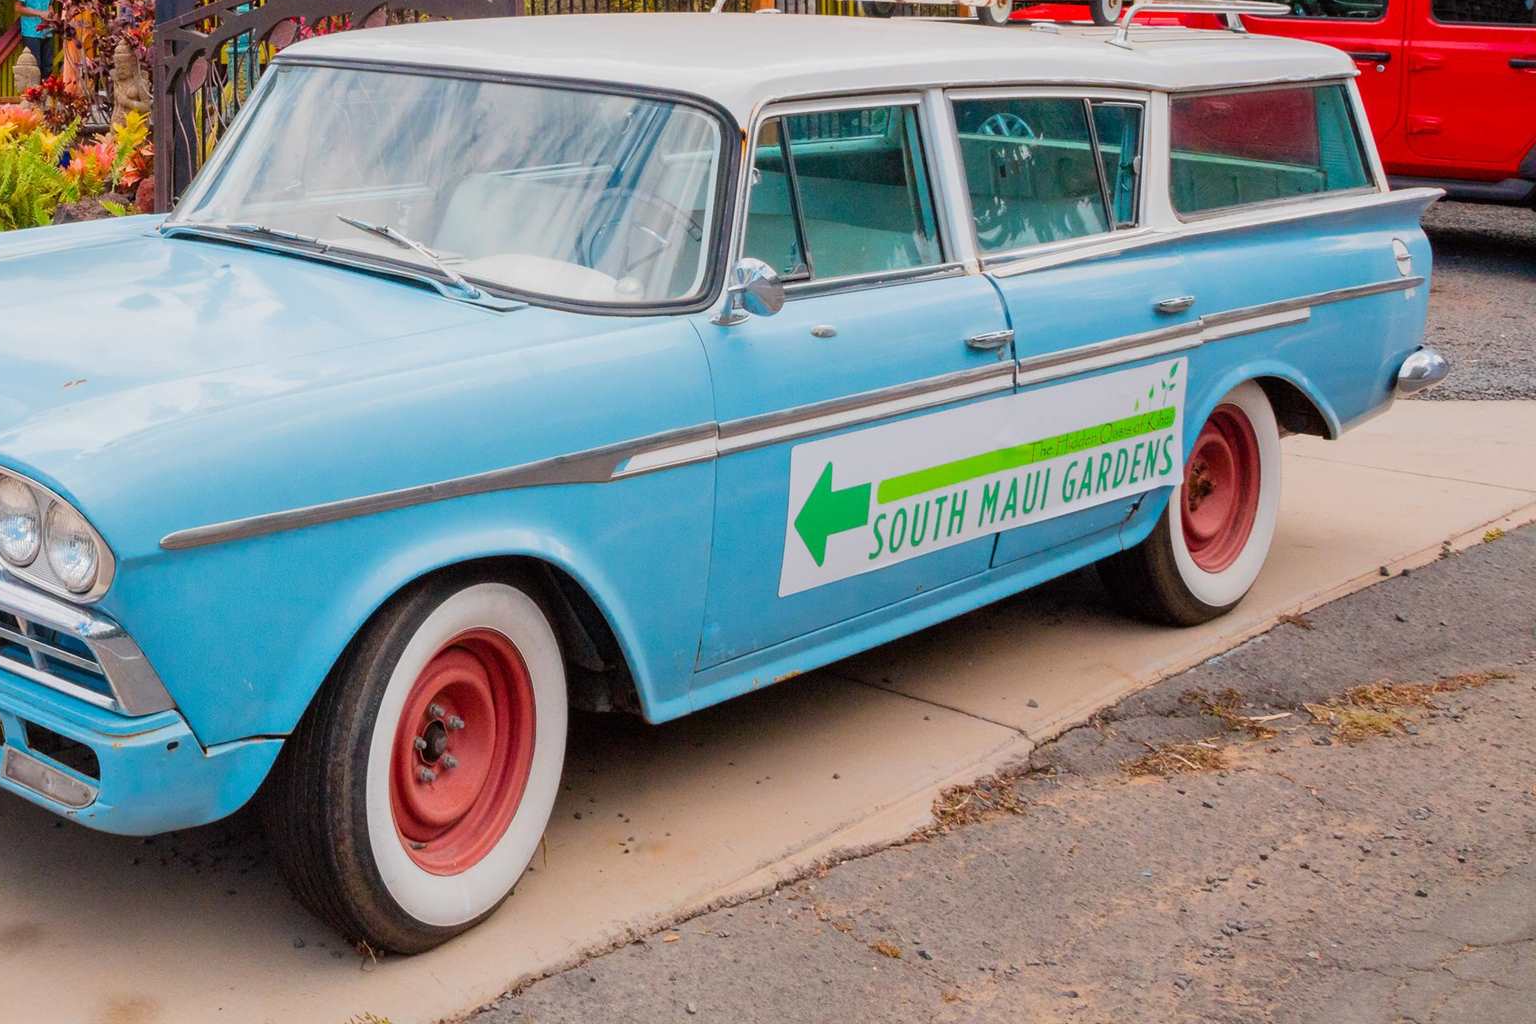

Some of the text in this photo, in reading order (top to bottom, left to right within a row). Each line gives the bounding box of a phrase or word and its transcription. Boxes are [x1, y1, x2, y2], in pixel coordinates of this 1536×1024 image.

[1030, 440, 1054, 463] The
[1099, 422, 1133, 444] Oasis
[868, 434, 1174, 560] SOUTH MAUI GARDENS
